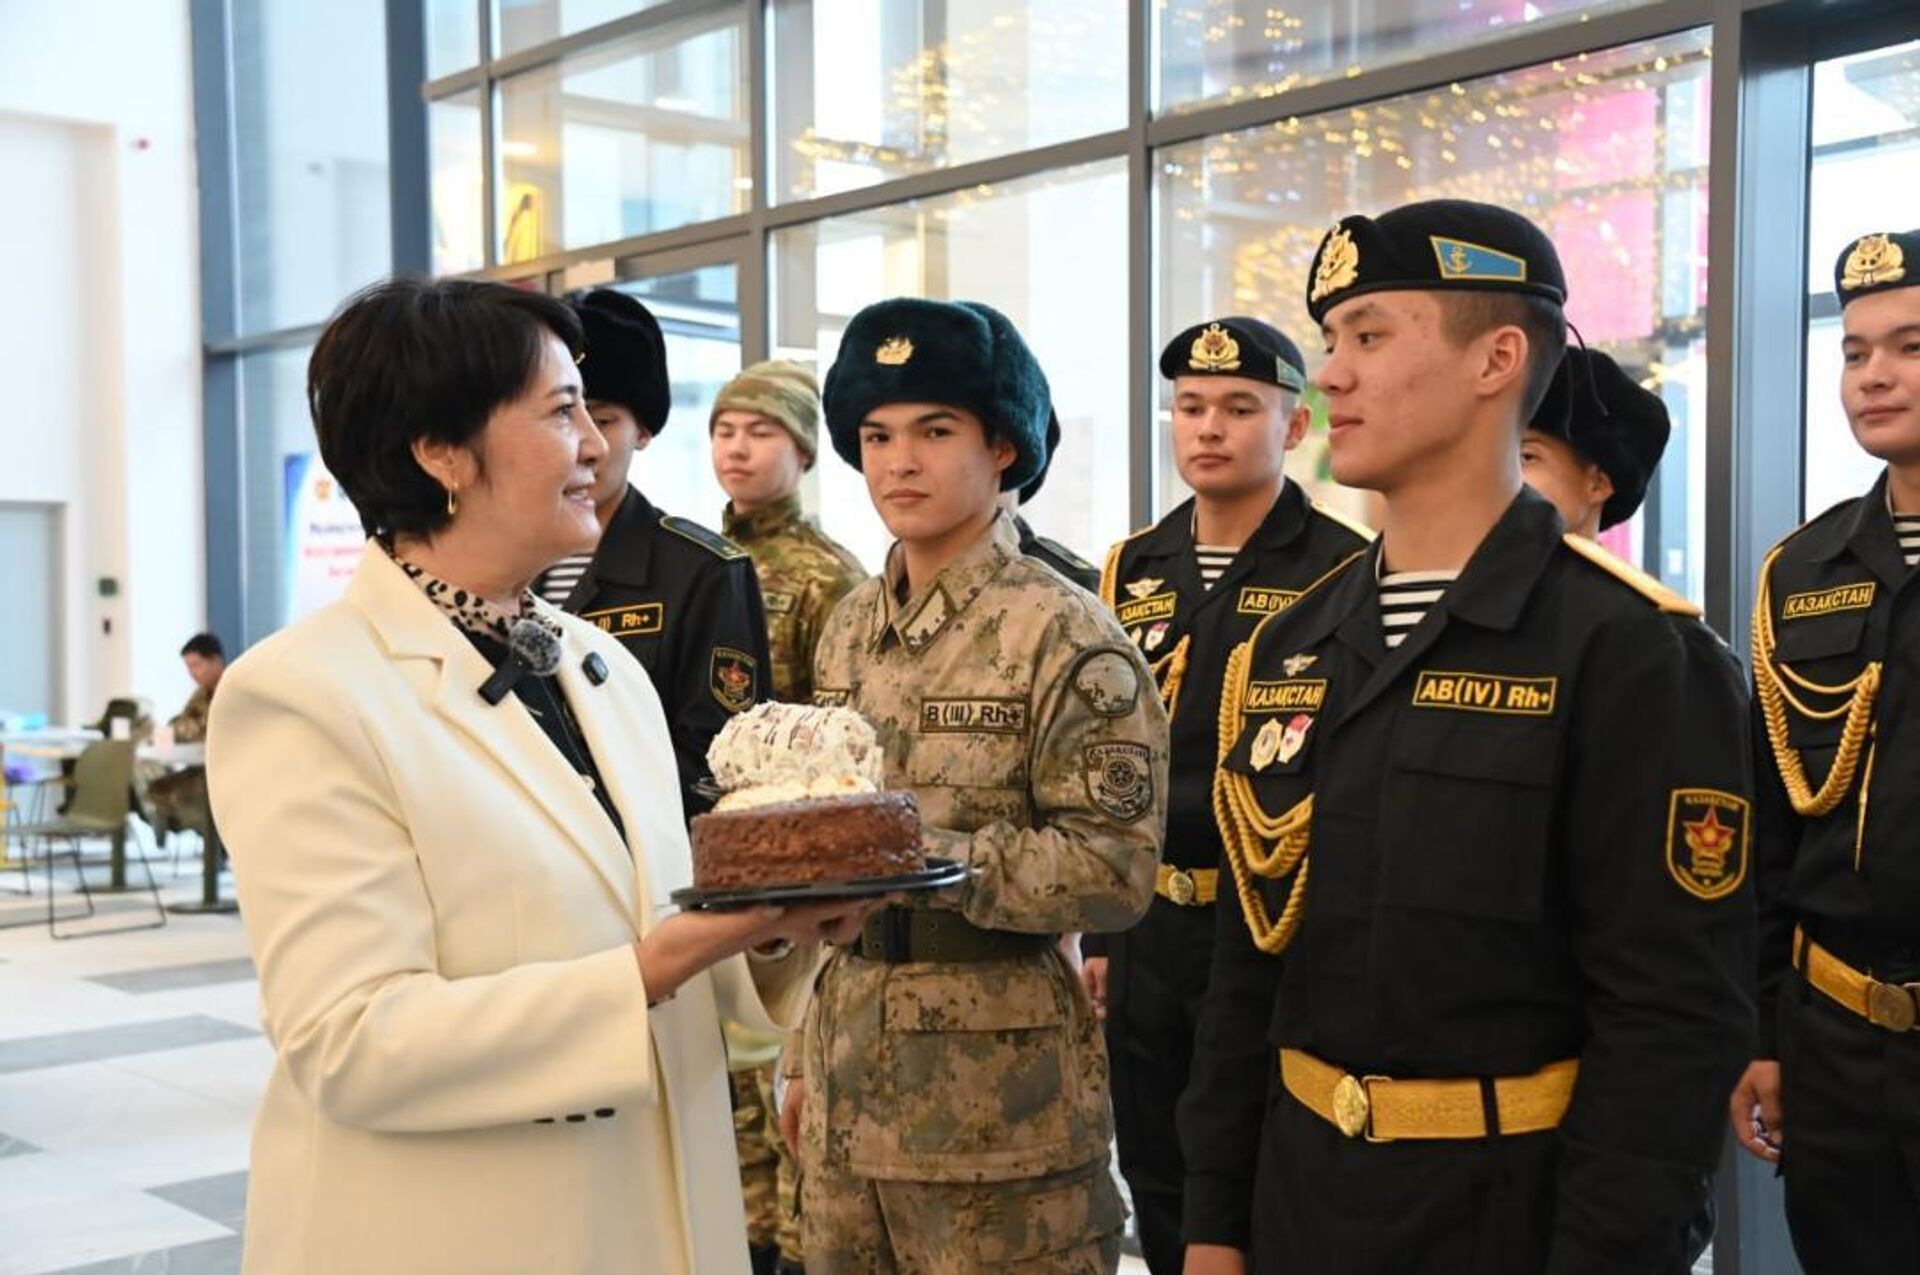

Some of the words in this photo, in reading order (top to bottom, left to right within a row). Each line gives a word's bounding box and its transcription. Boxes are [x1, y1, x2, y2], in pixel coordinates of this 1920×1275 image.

[1419, 677, 1501, 708] AB(IV)
[1506, 684, 1551, 708] Rh+
[927, 704, 973, 725] B(III)
[981, 704, 1021, 723] Rh+
